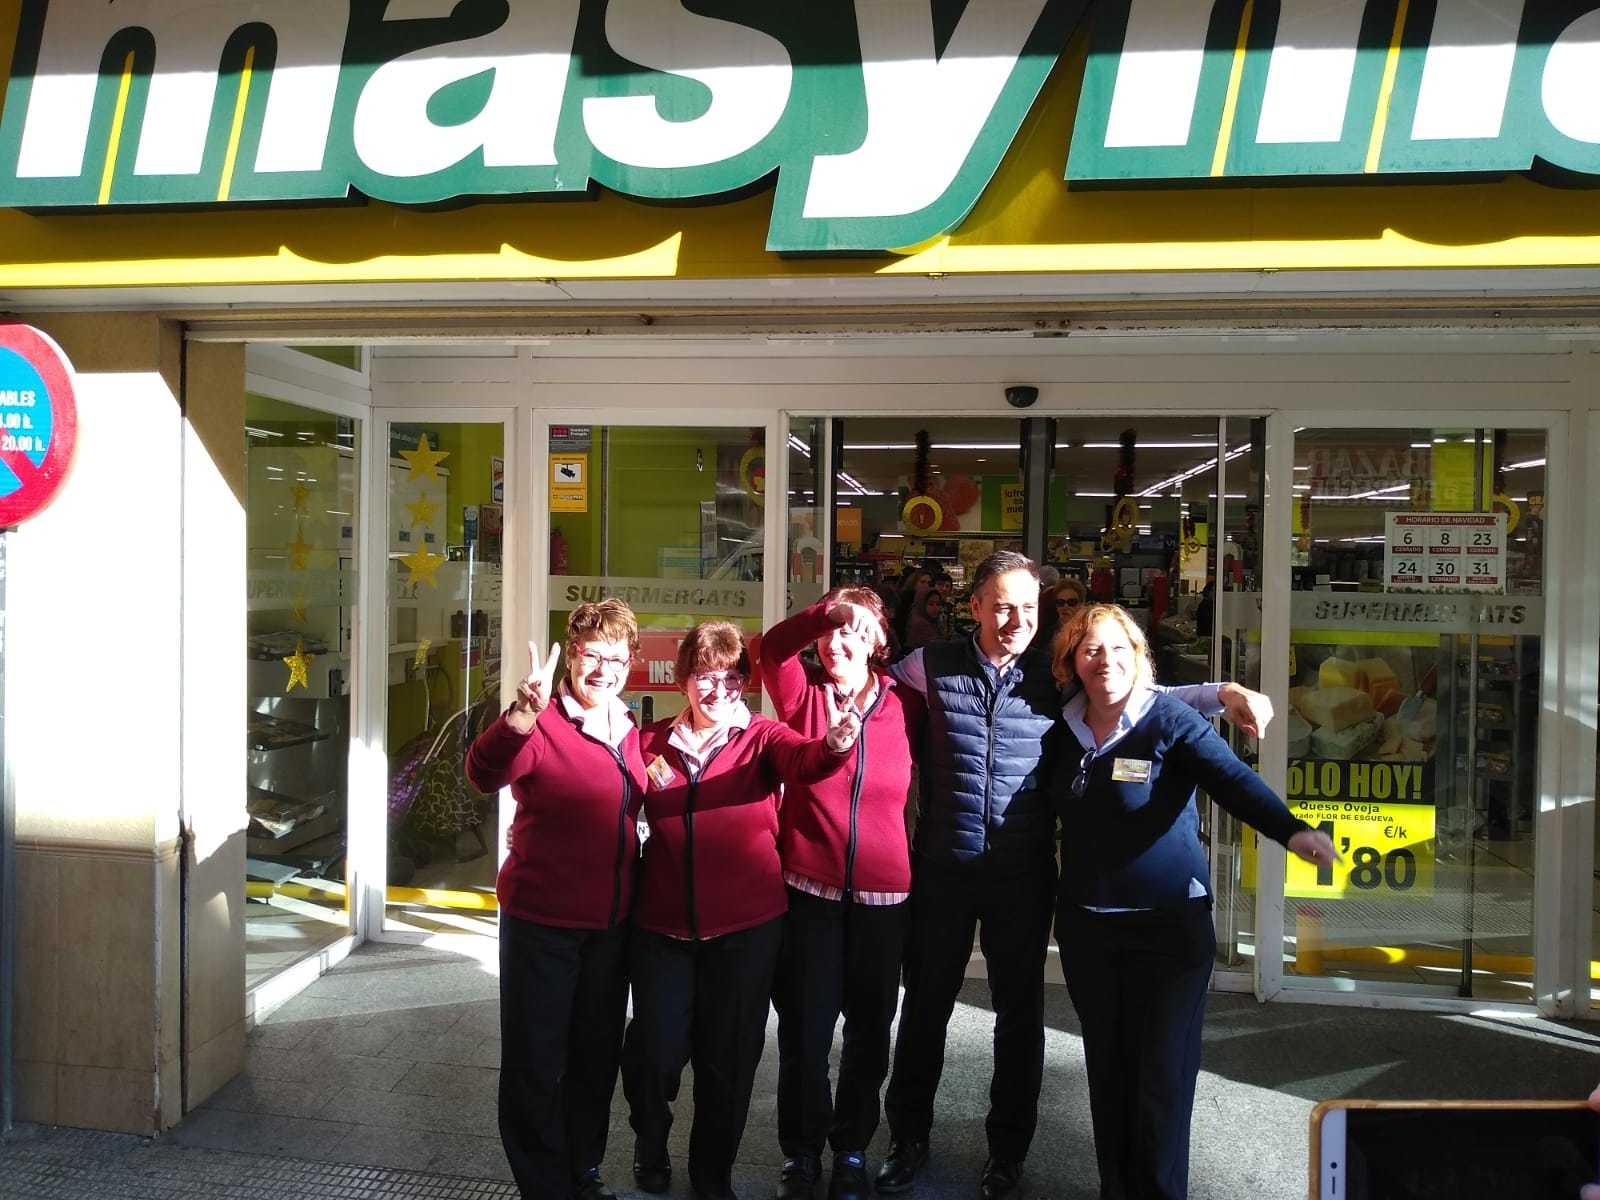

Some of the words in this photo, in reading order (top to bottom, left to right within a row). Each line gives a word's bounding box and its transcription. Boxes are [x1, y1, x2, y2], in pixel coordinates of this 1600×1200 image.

[14, 0, 1600, 220] masym
[0, 390, 36, 407] ABLES
[1, 435, 33, 452] 20.00
[1403, 532, 1413, 545] 6
[1440, 532, 1450, 545] 8
[1473, 533, 1492, 546] 23
[1398, 562, 1417, 574] 24
[1435, 562, 1455, 575] 30
[1472, 562, 1491, 575] 31
[565, 584, 748, 608] SUPERMERCATS
[1314, 599, 1528, 625] SUPERMERATS
[648, 659, 676, 684] INS
[1286, 760, 1341, 797] ÓLO
[1350, 763, 1423, 800] HOY!
[1300, 801, 1340, 812] Queso
[1344, 802, 1380, 815] Oveja
